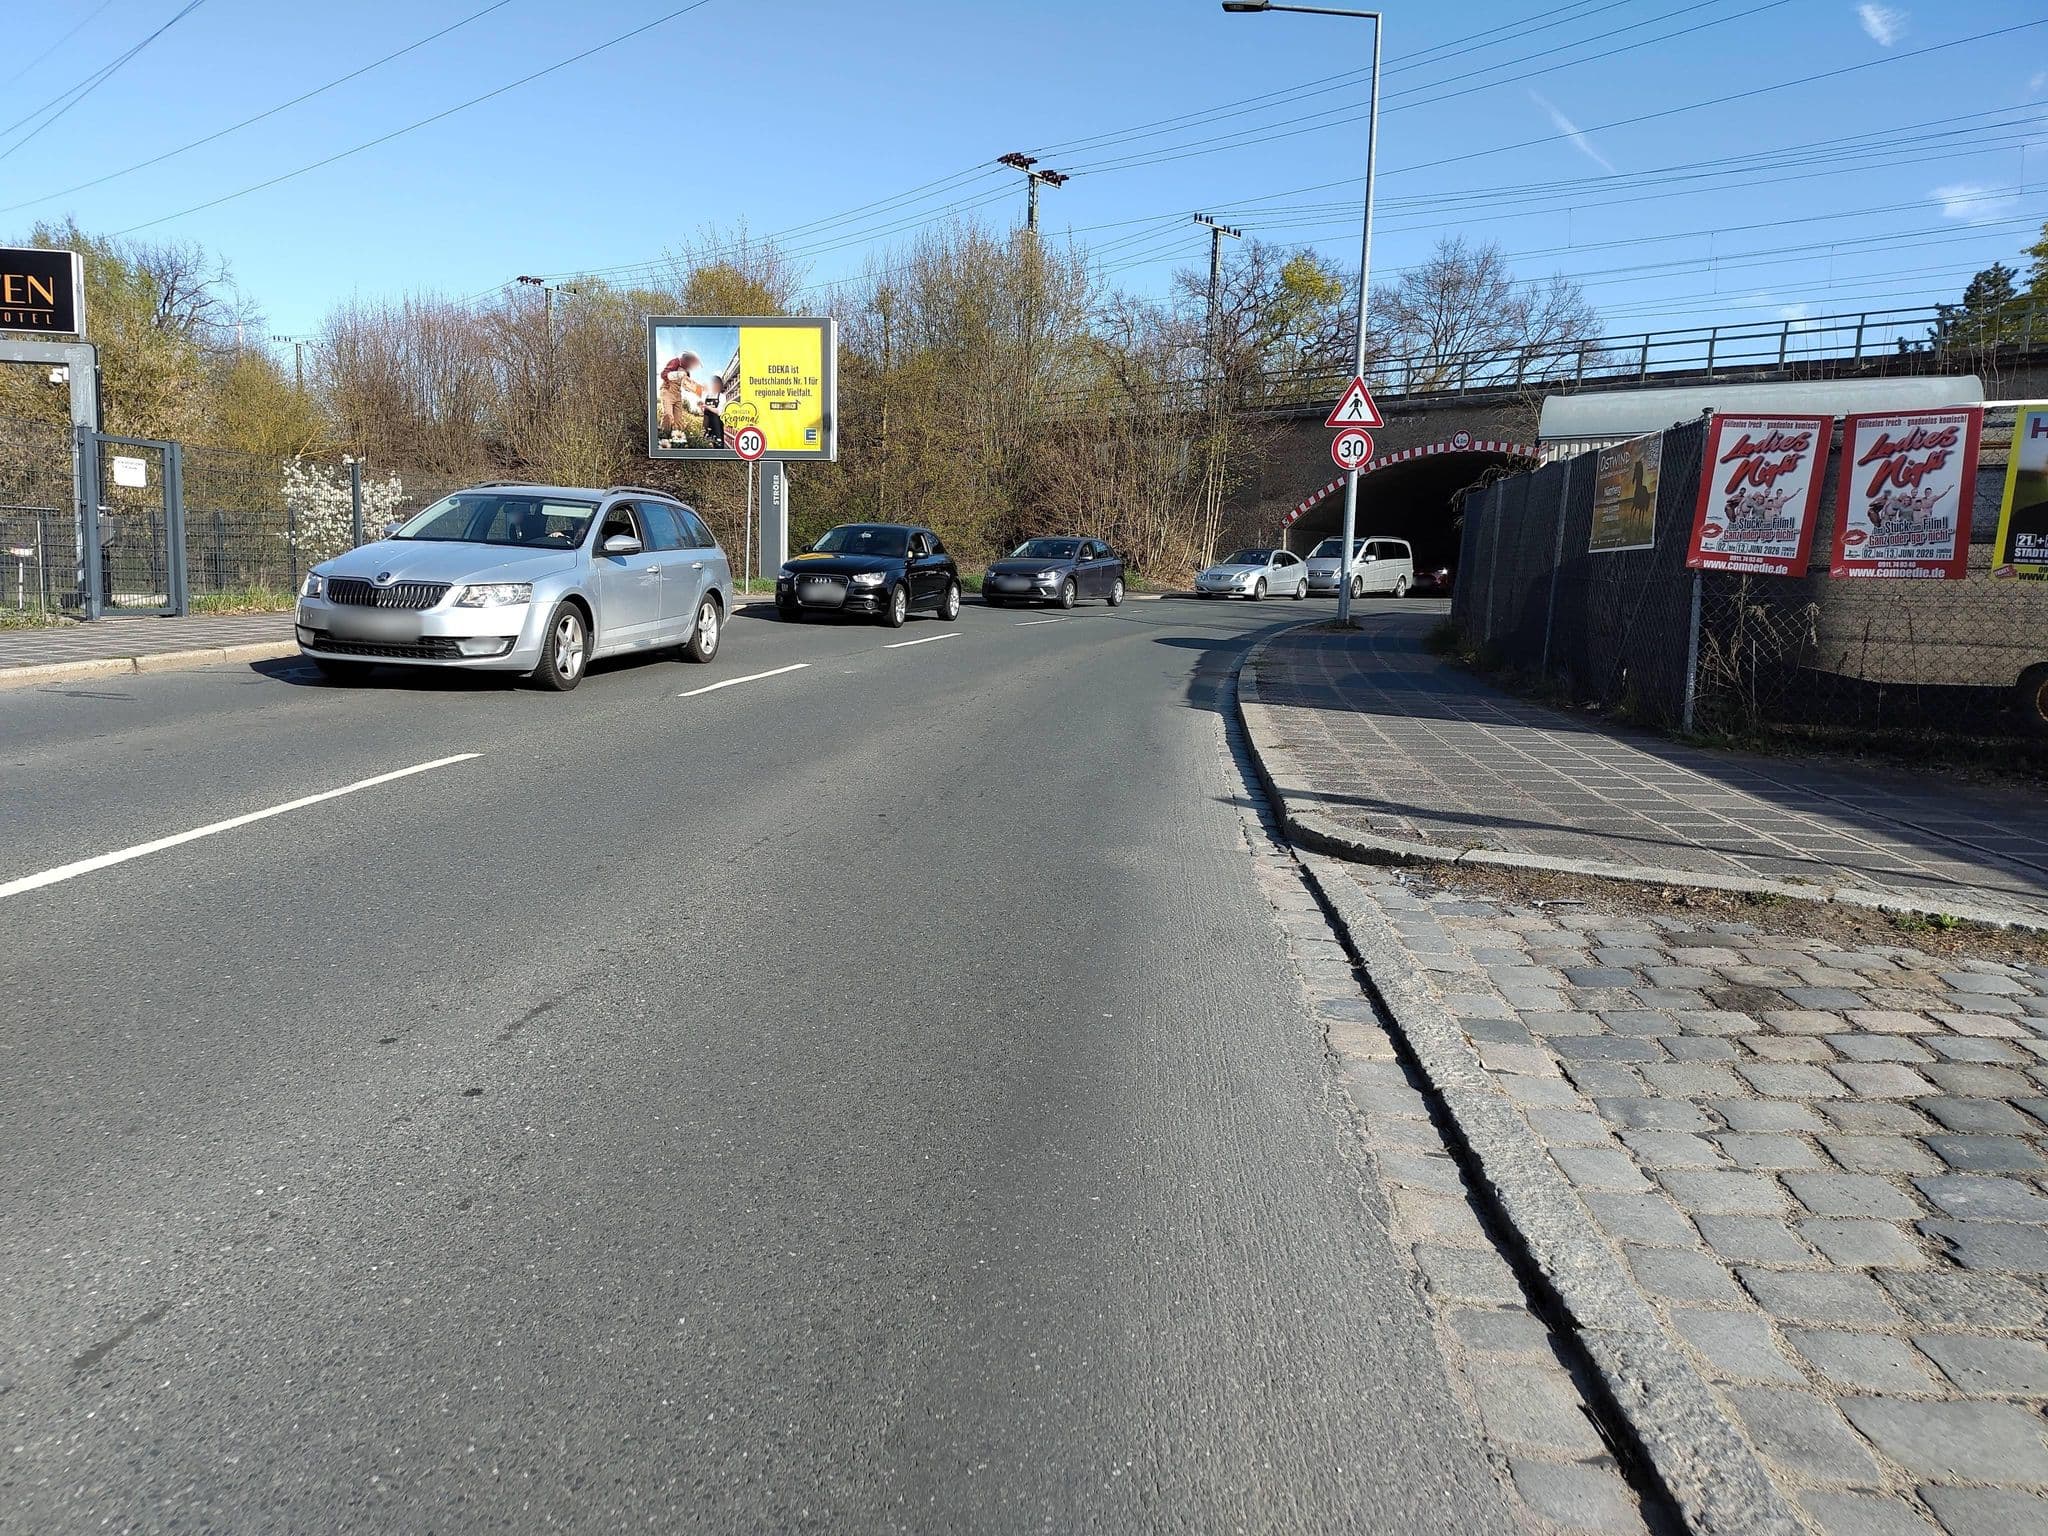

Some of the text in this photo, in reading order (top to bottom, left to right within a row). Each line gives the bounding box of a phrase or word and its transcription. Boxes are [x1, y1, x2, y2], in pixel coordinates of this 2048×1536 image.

[0, 274, 54, 305] EN
[768, 365, 799, 374] EDEKA ist
[749, 376, 792, 385] Deutschlands
[793, 376, 803, 385] Nr.
[808, 376, 819, 385] für
[755, 388, 813, 398] regionale Vielfalt.
[741, 436, 759, 451] 30
[1340, 440, 1364, 458] 30
[1720, 430, 1813, 464] Ladies
[1857, 426, 1960, 467] Ladies
[1724, 453, 1807, 495] Night
[1865, 449, 1955, 498] Night
[1738, 517, 1761, 530] Stück
[1885, 519, 1909, 533] Stück
[1741, 530, 1760, 541] oder
[1760, 531, 1775, 543] gar
[1889, 533, 1909, 545] oder
[1910, 533, 1926, 544] gar
[2018, 535, 2034, 546] 21.
[1748, 545, 1764, 554] JUNI
[1898, 549, 1915, 558] JUNI
[1915, 548, 1934, 558] 2026
[1703, 559, 1789, 574] www.comoedie.de
[1848, 567, 1946, 578] www.comoedie.de
[2018, 572, 2048, 581] www.
